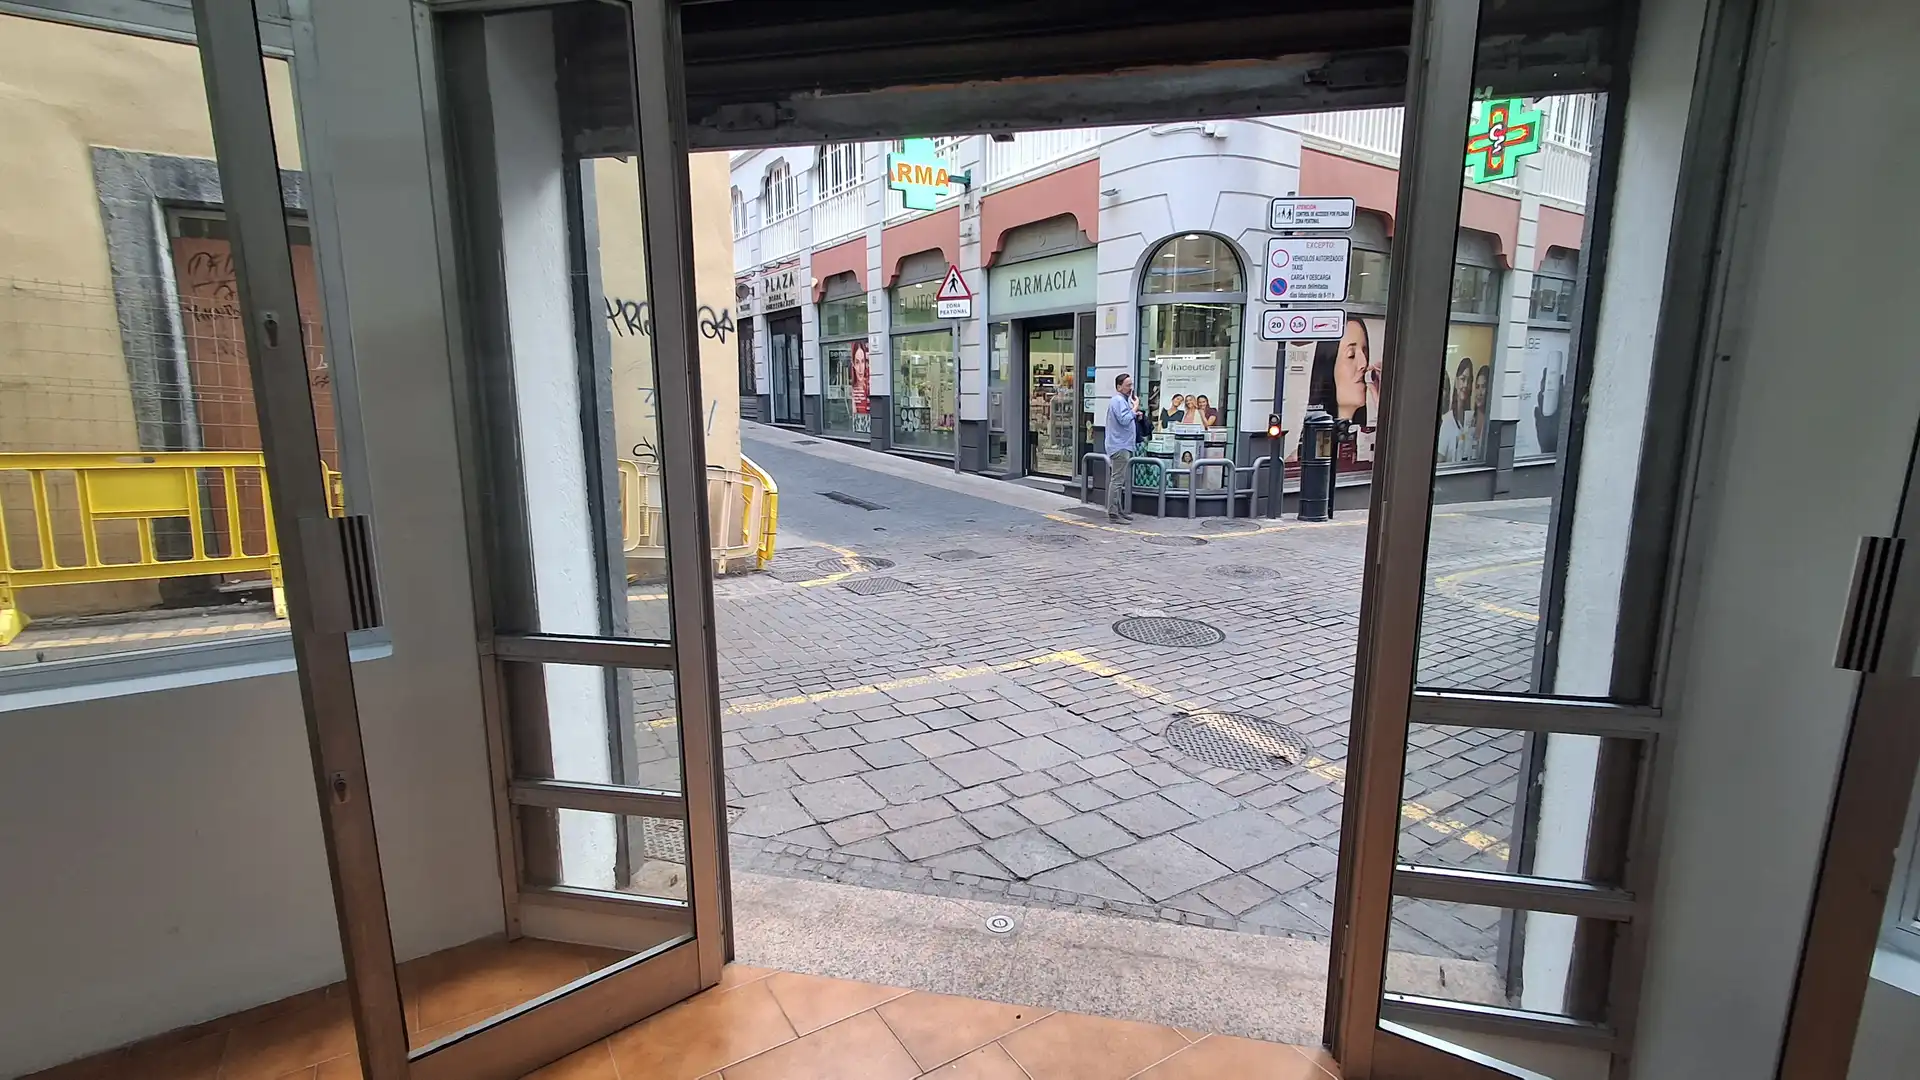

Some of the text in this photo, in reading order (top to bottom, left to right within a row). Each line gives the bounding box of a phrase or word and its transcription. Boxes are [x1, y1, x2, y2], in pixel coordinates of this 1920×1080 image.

[764, 271, 795, 294] PLAZA
[1009, 268, 1077, 298] FARMACIA
[1271, 321, 1282, 329] 20
